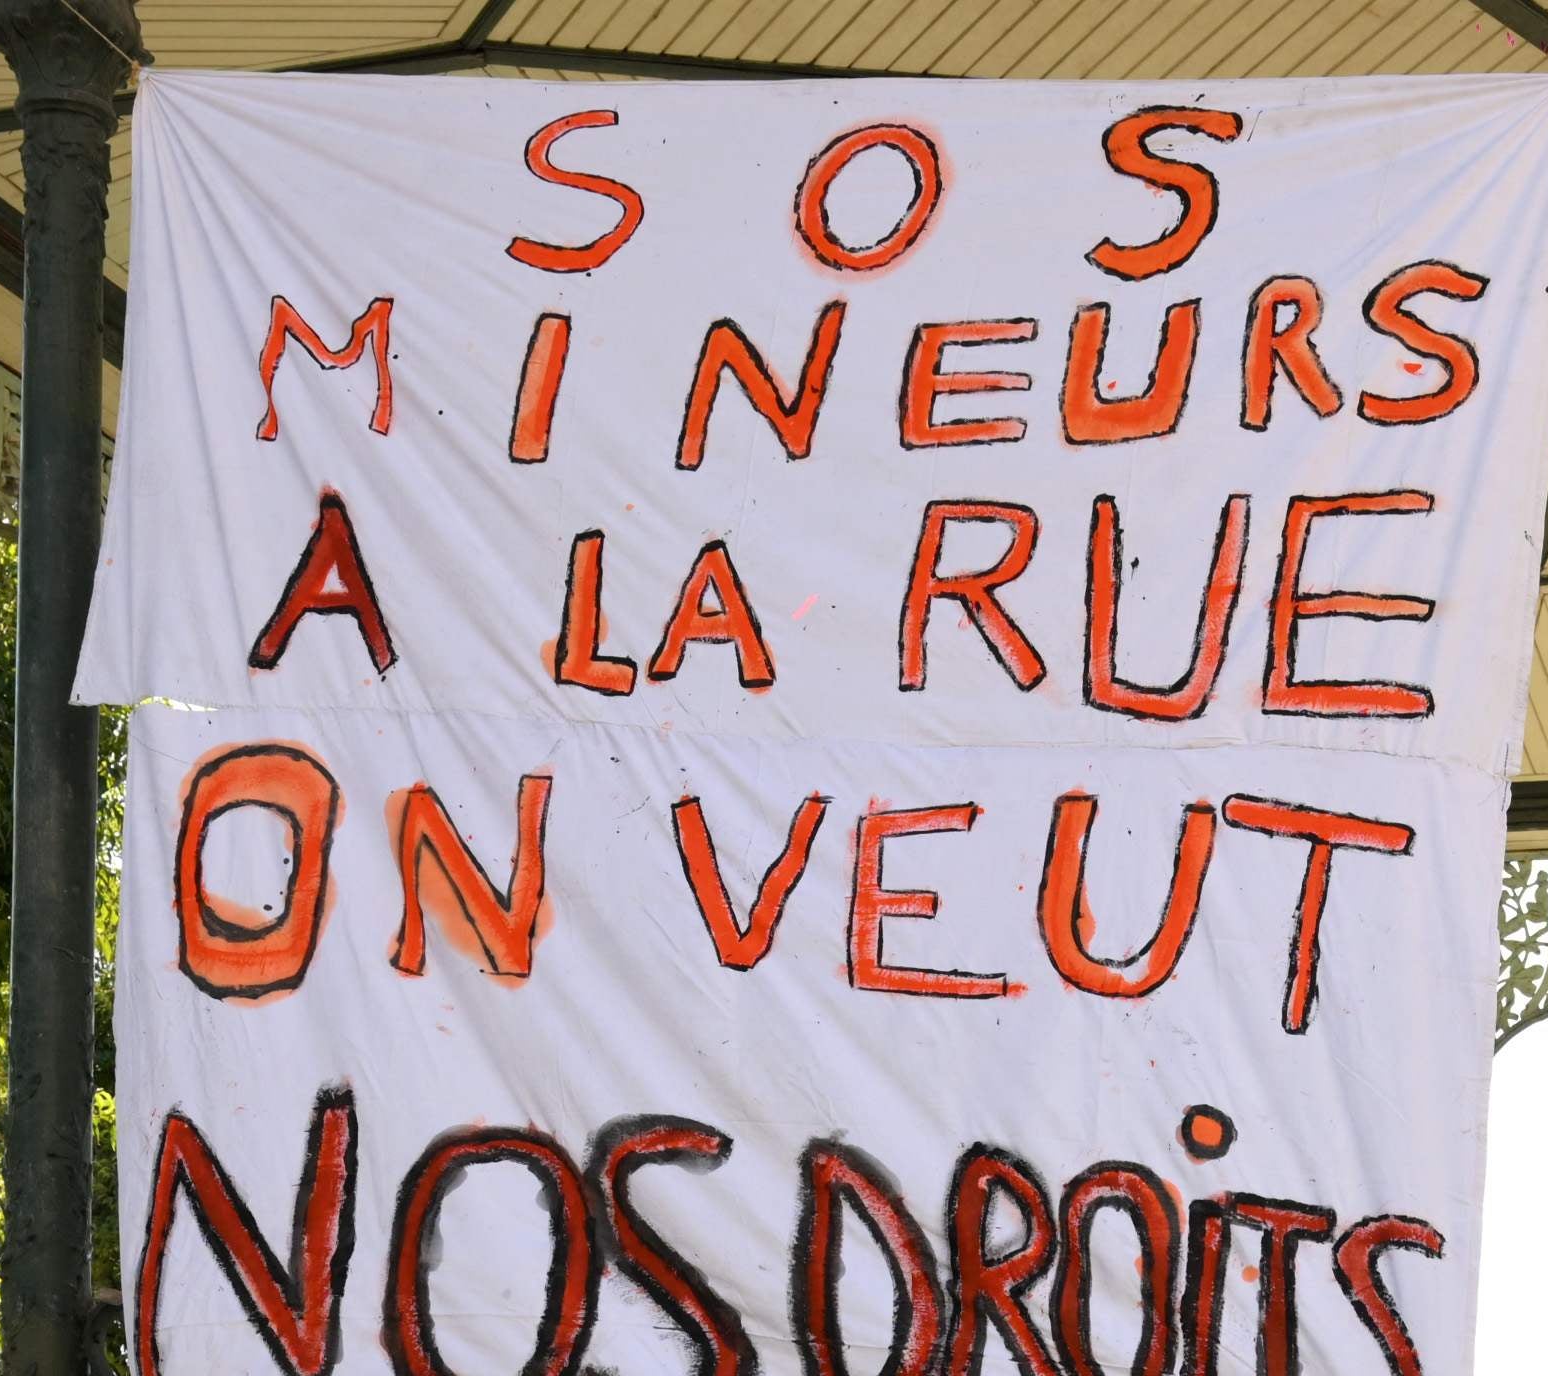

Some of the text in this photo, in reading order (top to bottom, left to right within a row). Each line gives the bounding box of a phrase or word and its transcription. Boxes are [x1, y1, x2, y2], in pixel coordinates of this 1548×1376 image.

[504, 106, 1242, 281] SOS
[256, 260, 1490, 470] MINEURS
[248, 487, 1436, 720] A LA RUE
[177, 741, 1415, 1034] ON VEUT
